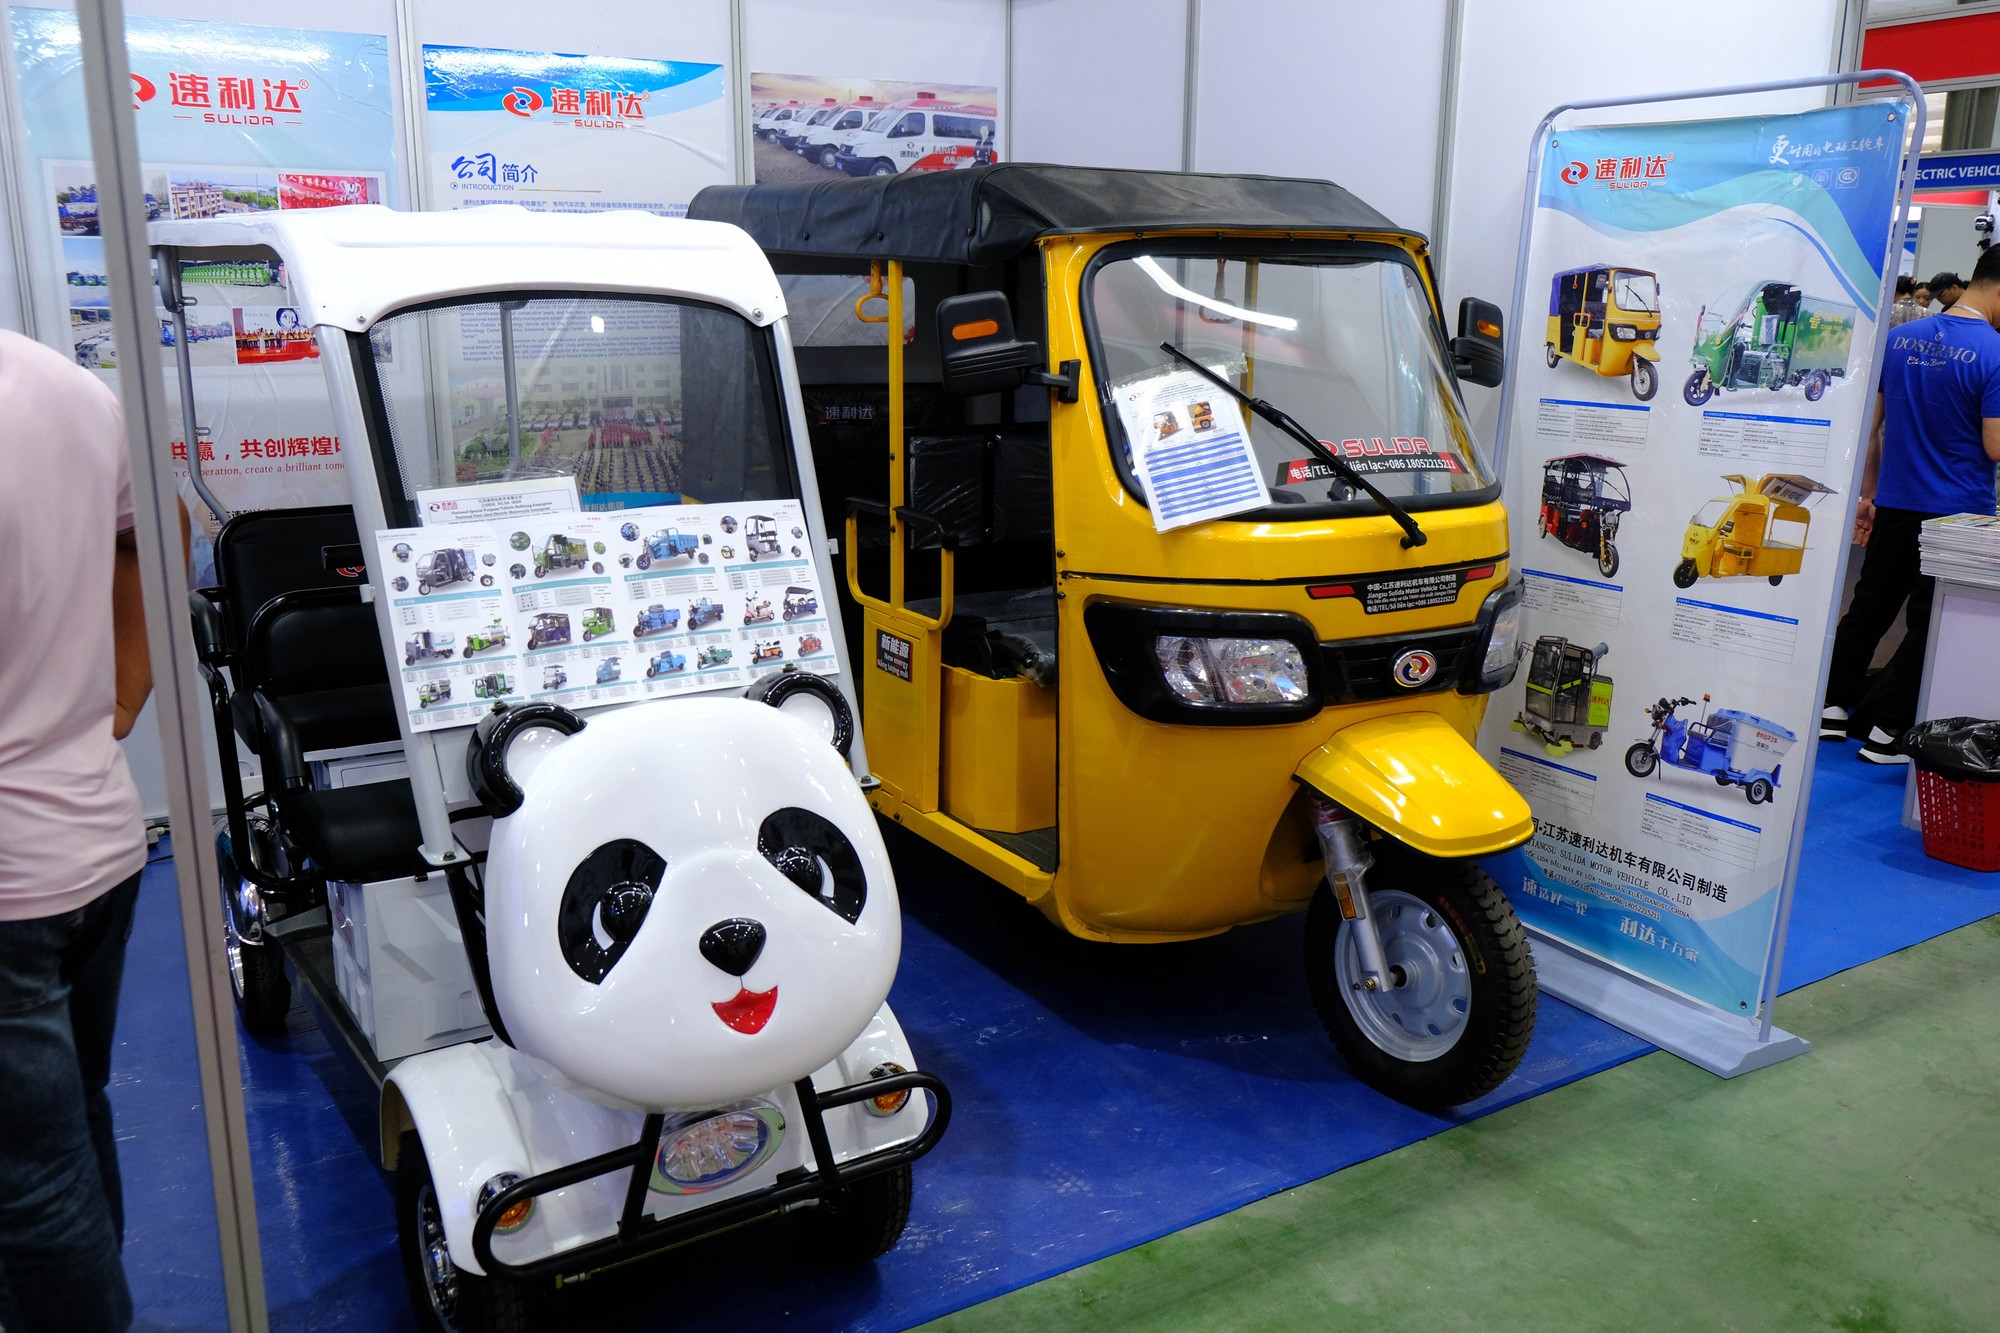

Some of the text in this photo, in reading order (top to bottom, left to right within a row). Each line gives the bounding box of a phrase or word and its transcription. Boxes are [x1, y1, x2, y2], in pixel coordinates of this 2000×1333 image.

[169, 72, 302, 114] 速利达
[551, 87, 644, 119] 速利达
[203, 113, 274, 126] SULIDA
[574, 118, 625, 129] SULIDA
[451, 153, 538, 184] 公司简介
[1594, 155, 1667, 182] 速利达
[461, 183, 514, 191] INTRODUCTION
[1608, 180, 1648, 191] SULIDA
[825, 405, 873, 420] 速利达
[1341, 437, 1432, 458] SULIDA
[245, 464, 273, 475] create
[285, 462, 322, 472] brilliant
[1407, 459, 1456, 470] 18052215211
[1367, 591, 1387, 599] Jiangsu
[1388, 589, 1404, 597] Sulida
[881, 633, 909, 659] 新能源
[1559, 849, 1586, 867] SULIDA
[1590, 860, 1613, 876] MOTOR
[1616, 870, 1650, 890] VEHICLE
[1624, 900, 1660, 920] 18052215211
[1670, 907, 1690, 918] CHINA
